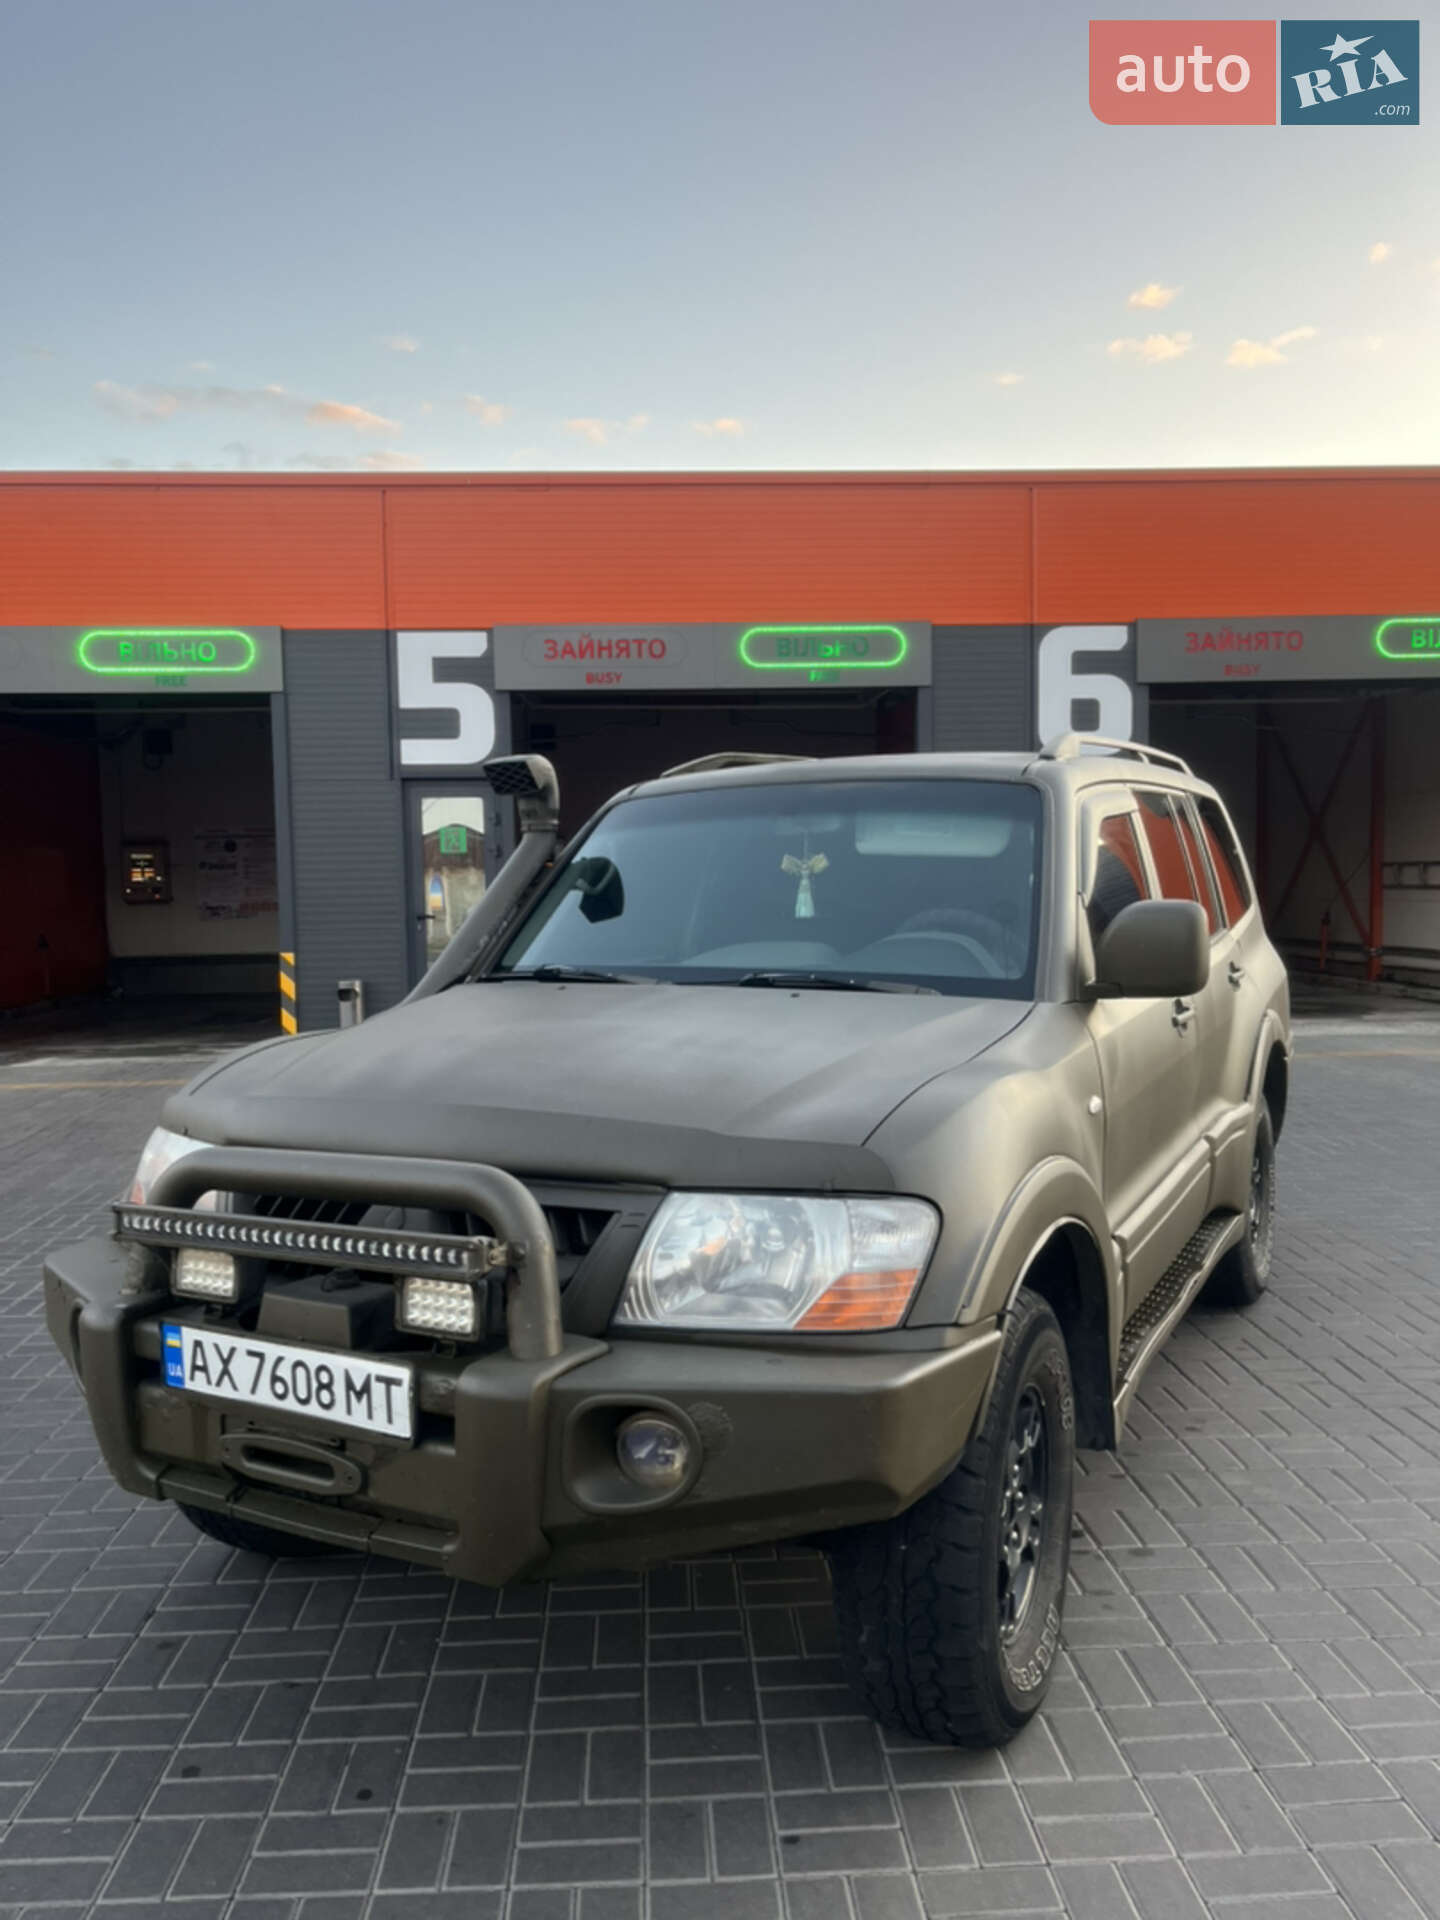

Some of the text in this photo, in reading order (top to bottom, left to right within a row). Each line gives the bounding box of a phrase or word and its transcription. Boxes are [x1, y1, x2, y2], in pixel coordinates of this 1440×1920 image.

[118, 641, 217, 663] ВІЛЬНО
[544, 635, 666, 661] ЗАЙНЯТО
[1185, 628, 1303, 653] ЗАЙНЯТО
[585, 672, 622, 685] BUSY
[1038, 625, 1133, 755] 6
[397, 632, 495, 766] 5
[167, 1363, 183, 1378] UA
[189, 1340, 403, 1425] AX 7608 MT
